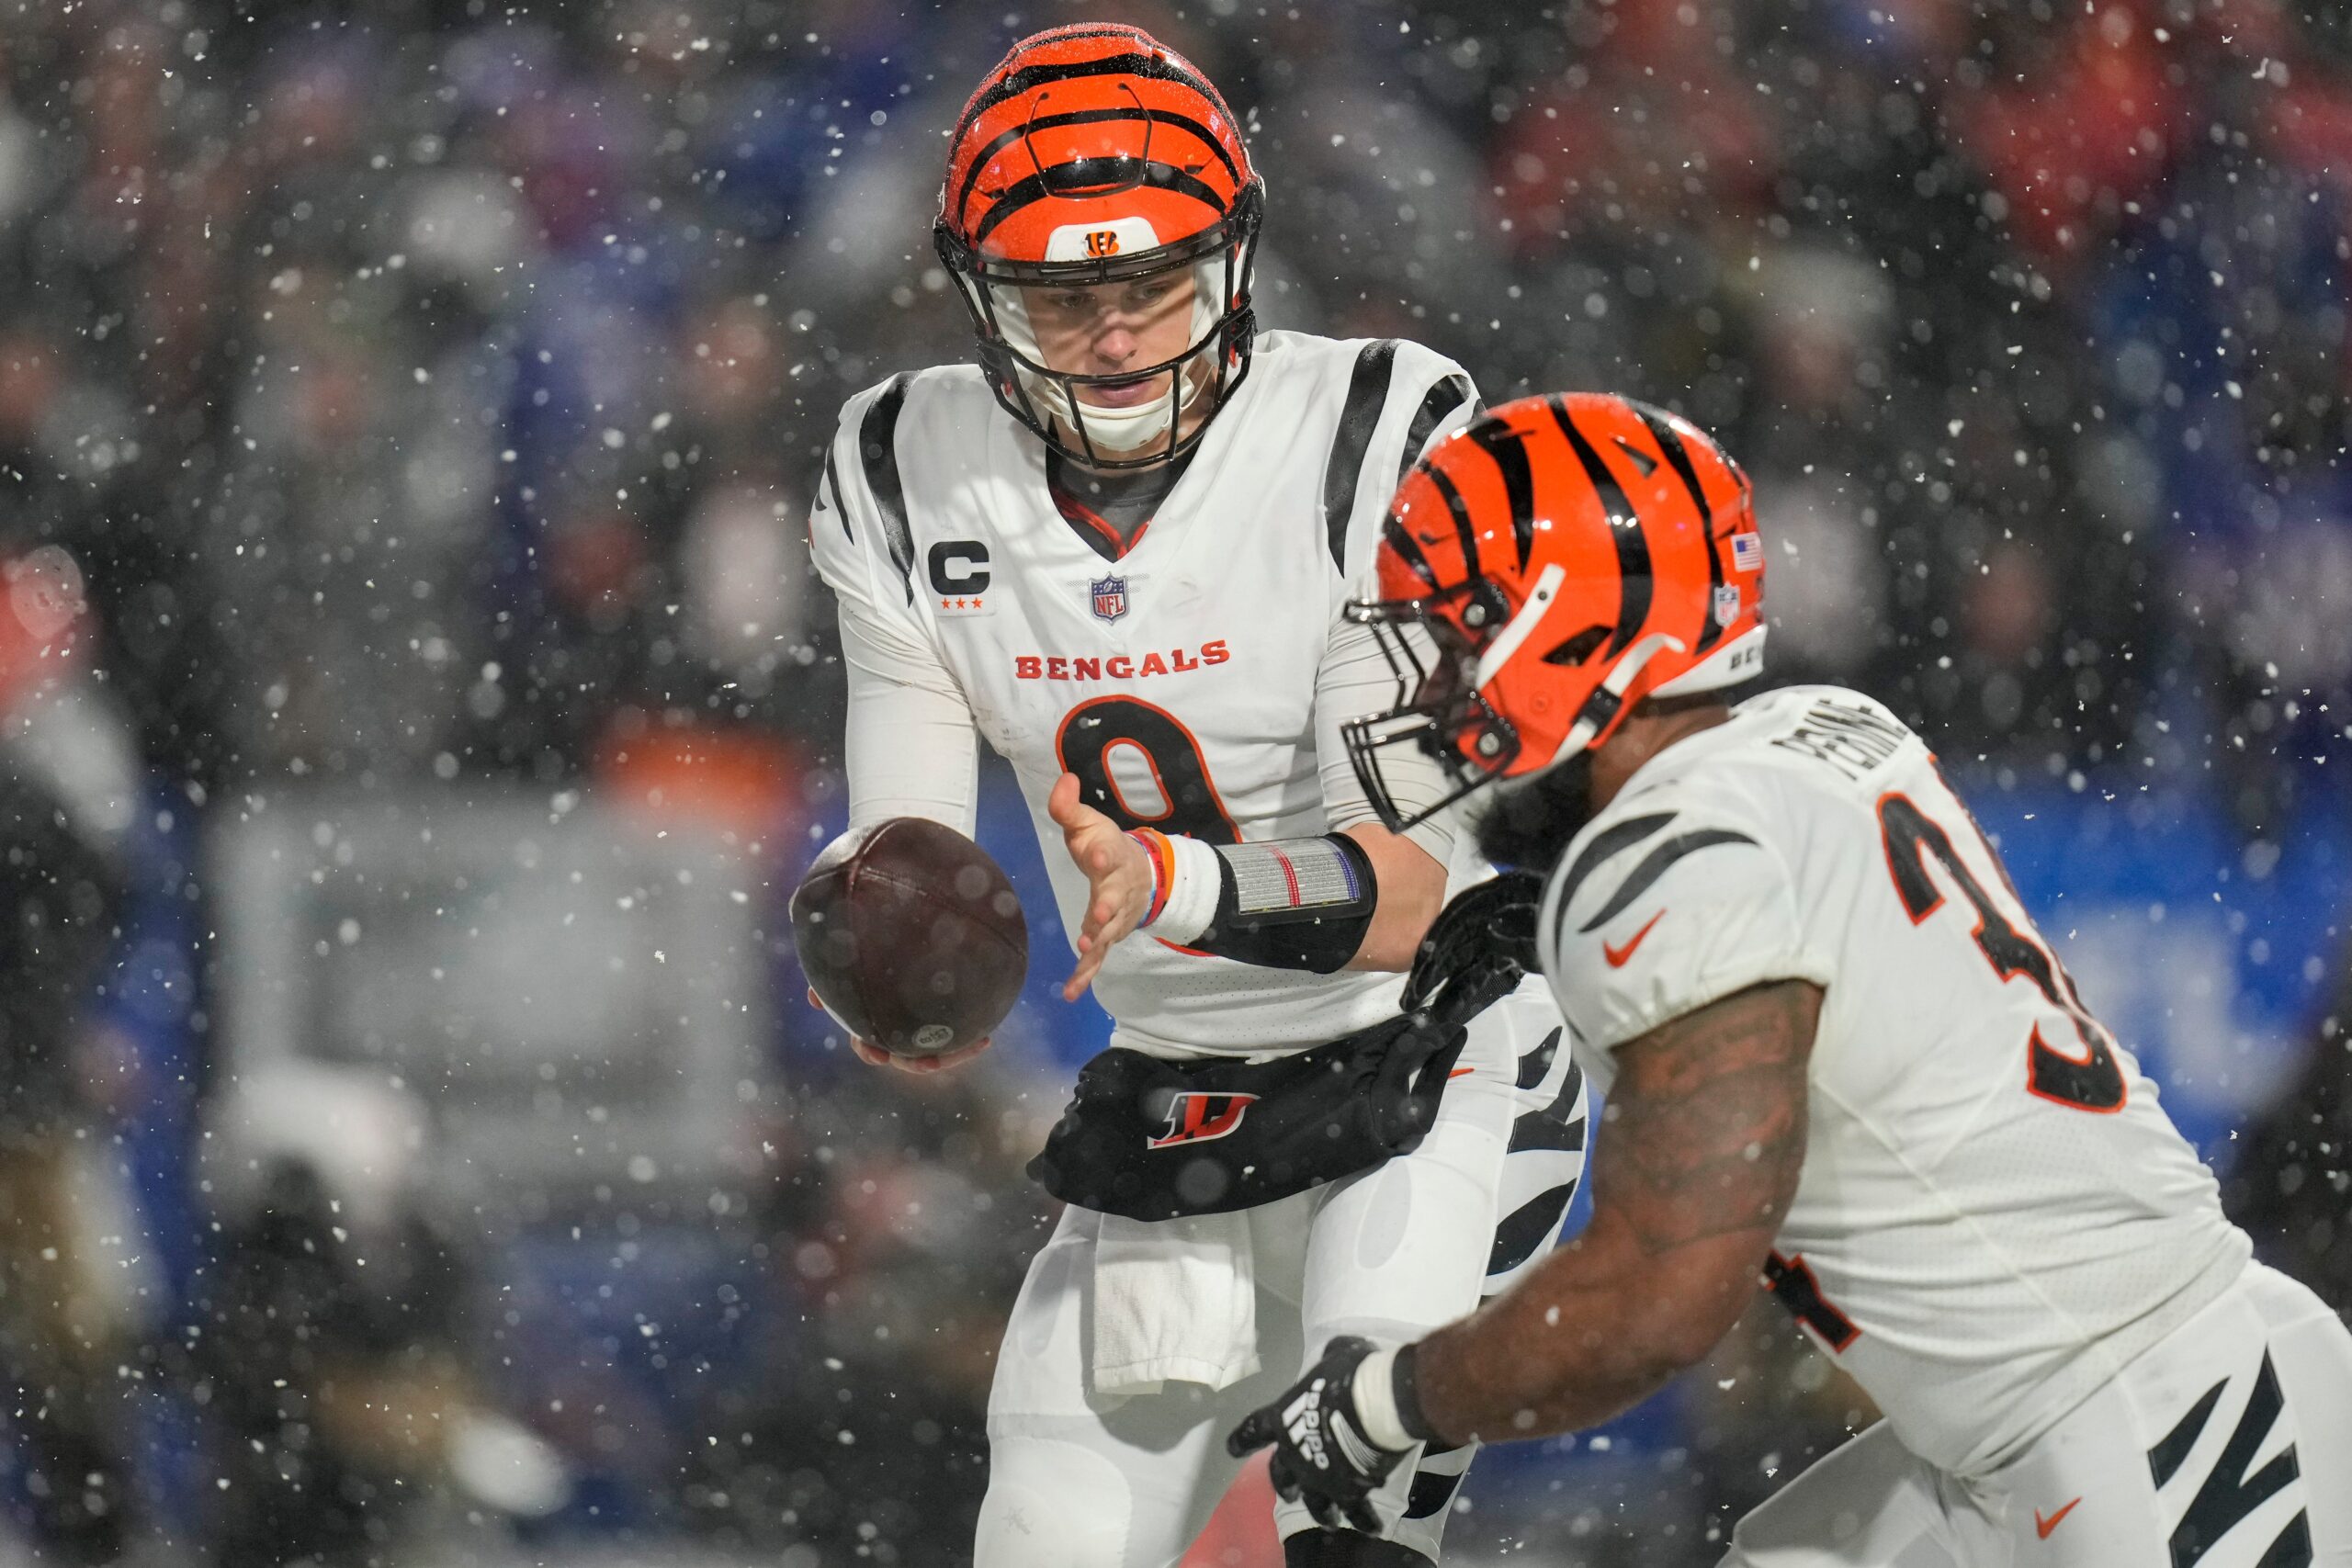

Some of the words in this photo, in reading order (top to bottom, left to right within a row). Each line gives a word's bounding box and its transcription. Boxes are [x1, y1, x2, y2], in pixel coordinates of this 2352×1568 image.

[928, 540, 991, 595] C
[1095, 594, 1124, 615] NFL
[1015, 639, 1231, 681] BENGALS
[1302, 1378, 1330, 1470] adidas
